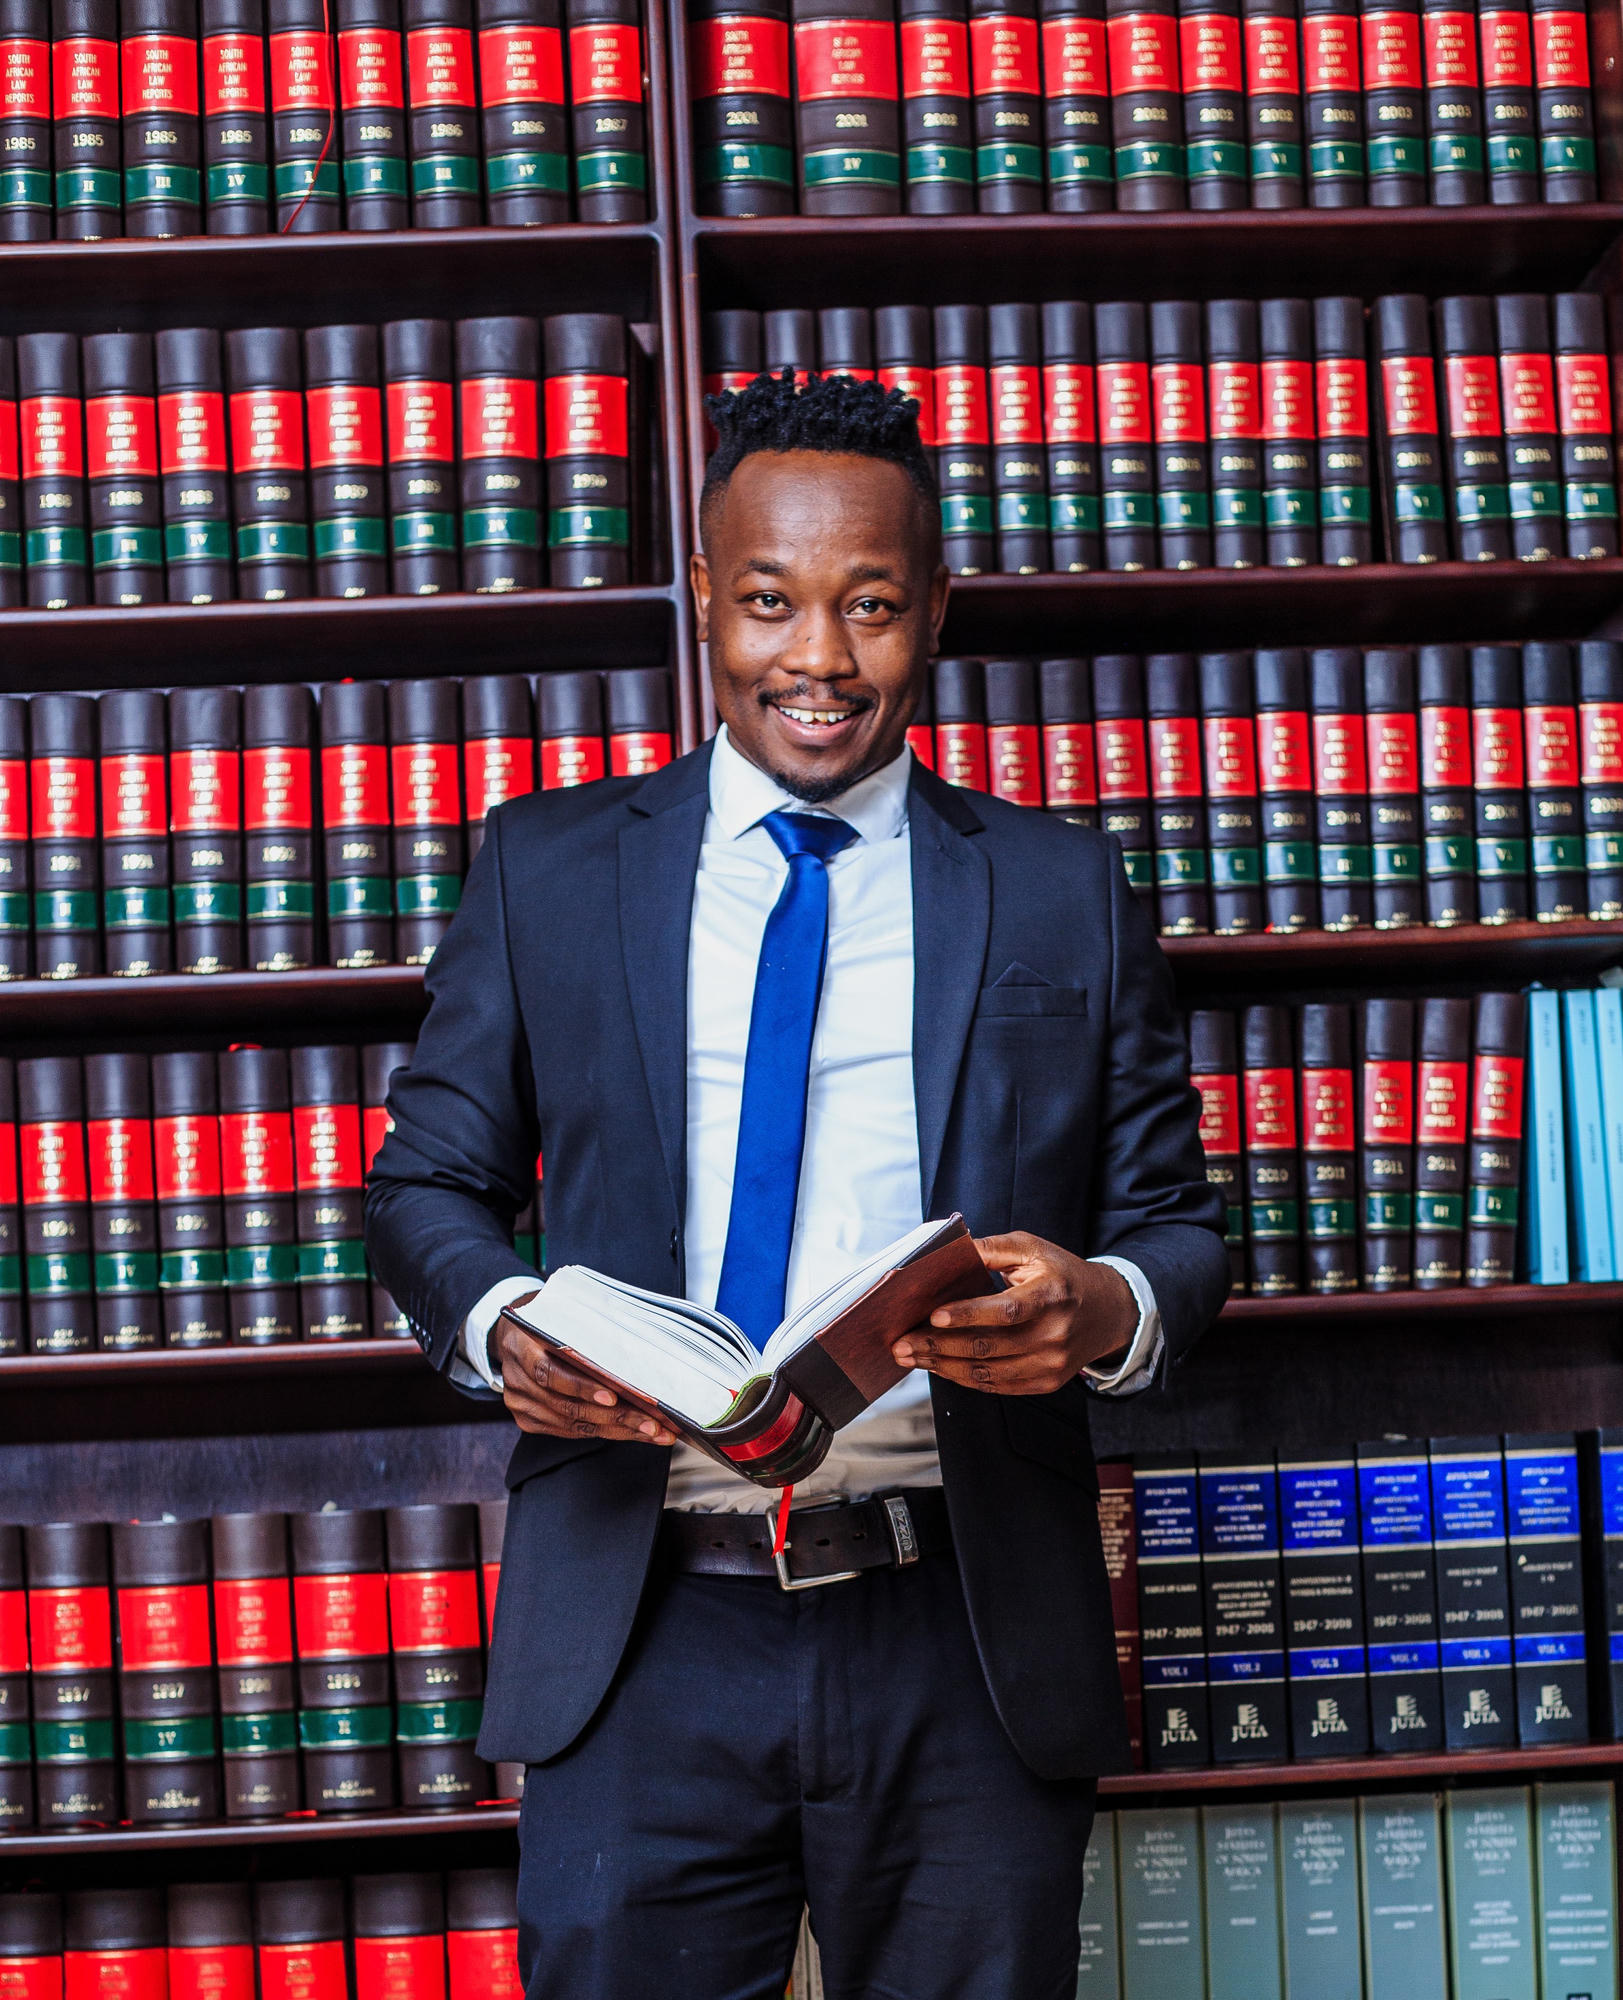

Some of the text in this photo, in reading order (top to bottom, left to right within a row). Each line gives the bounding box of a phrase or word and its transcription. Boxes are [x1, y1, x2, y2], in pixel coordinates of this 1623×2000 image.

[725, 31, 749, 42] SOUTH
[359, 43, 382, 53] SOUTH
[429, 43, 453, 54] SOUTH
[508, 41, 532, 52] SOUTH
[594, 38, 618, 49] SOUTH
[146, 50, 168, 61] SOUTH
[220, 49, 243, 60] SOUTH
[291, 47, 314, 57] SOUTH
[591, 51, 621, 62] AFRICAN
[8, 53, 31, 64] SOUTH
[74, 53, 97, 64] SOUTH
[356, 56, 386, 67] AFRICAN
[427, 56, 456, 67] AFRICAN
[506, 54, 536, 65] AFRICAN
[728, 57, 746, 68] LAW
[143, 63, 172, 74] AFRICAN
[218, 63, 247, 73] AFRICAN
[288, 60, 318, 71] AFRICAN
[598, 64, 615, 75] LAW
[5, 68, 33, 78] AFRICAN
[72, 67, 100, 78] AFRICAN
[363, 69, 380, 79] LAW
[433, 69, 450, 80] LAW
[512, 67, 529, 77] LAW
[149, 76, 165, 87] LAW
[224, 75, 240, 86] LAW
[294, 73, 311, 83] LAW
[591, 77, 621, 89] REPORTS
[11, 80, 27, 90] LAW
[77, 80, 93, 90] LAW
[356, 82, 388, 93] REPORTS
[427, 82, 459, 93] REPORTS
[506, 80, 538, 91] REPORTS
[142, 89, 173, 100] REPORTS
[218, 88, 248, 99] REPORTS
[288, 86, 319, 96] REPORTS
[5, 93, 34, 103] REPORTS
[71, 93, 102, 103] REPORTS
[1378, 106, 1413, 120] 2003
[1438, 105, 1472, 119] 2003
[512, 121, 546, 134] 1986
[595, 118, 629, 132] 1987
[290, 129, 322, 142] 1986
[360, 126, 393, 140] 1986
[431, 124, 464, 138] 1986
[73, 133, 104, 147] 1985
[145, 131, 177, 144] 1985
[220, 130, 252, 144] 1985
[4, 137, 36, 150] 1985
[155, 176, 171, 189] III
[228, 175, 246, 188] IV
[1426, 1156, 1457, 1172] 2011
[1480, 1152, 1510, 1168] 2011
[1373, 1159, 1404, 1174] 2011
[1317, 1166, 1346, 1181] 2011
[1463, 1710, 1500, 1729] JUTA
[1535, 1706, 1572, 1724] JUTA
[1311, 1720, 1348, 1738] JUTA
[1391, 1716, 1427, 1734] JUTA
[1161, 1729, 1199, 1746] JUTA
[1232, 1726, 1269, 1743] JUTA
